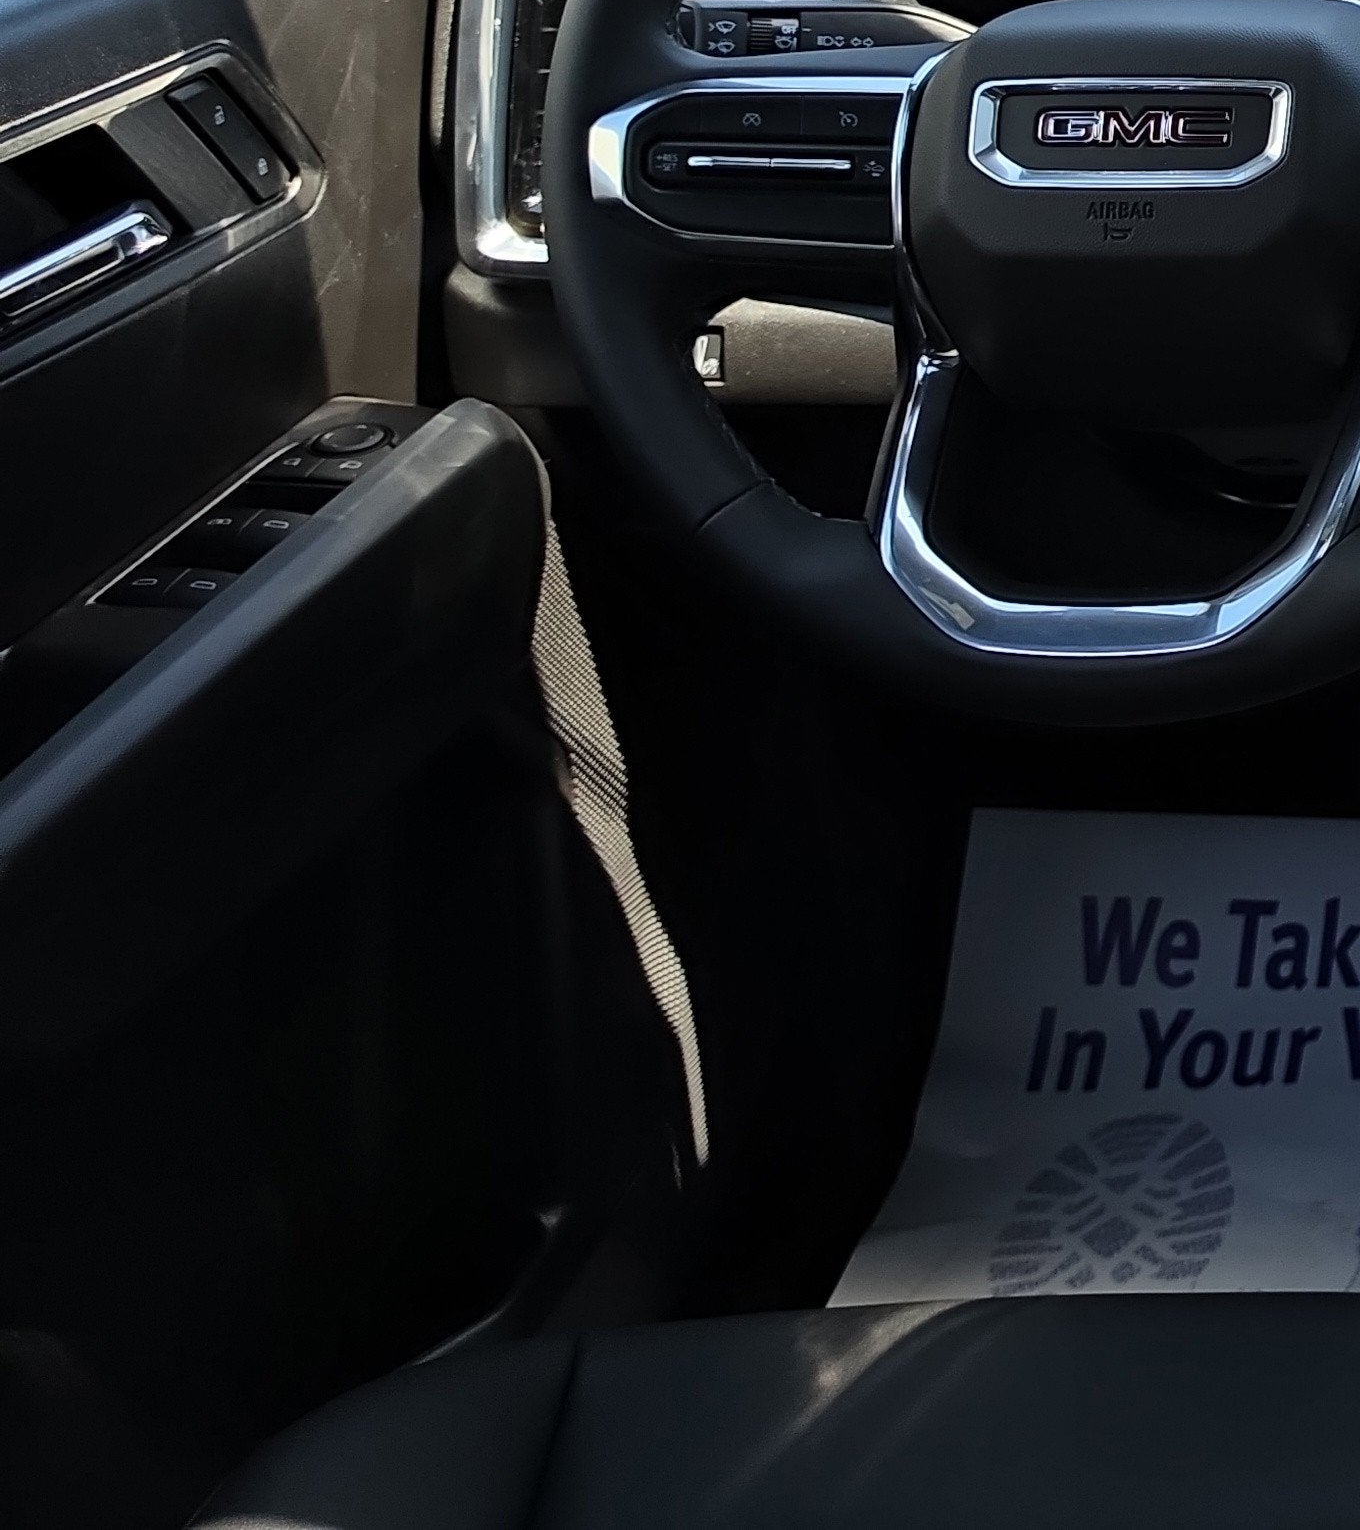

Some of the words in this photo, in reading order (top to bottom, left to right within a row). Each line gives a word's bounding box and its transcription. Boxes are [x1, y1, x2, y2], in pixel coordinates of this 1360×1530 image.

[780, 25, 798, 34] OFF
[1036, 108, 1233, 145] GMC
[1086, 201, 1155, 220] AIRBAG
[1081, 895, 1200, 988] We
[1025, 1007, 1108, 1094] In
[1137, 1006, 1322, 1092] Your
